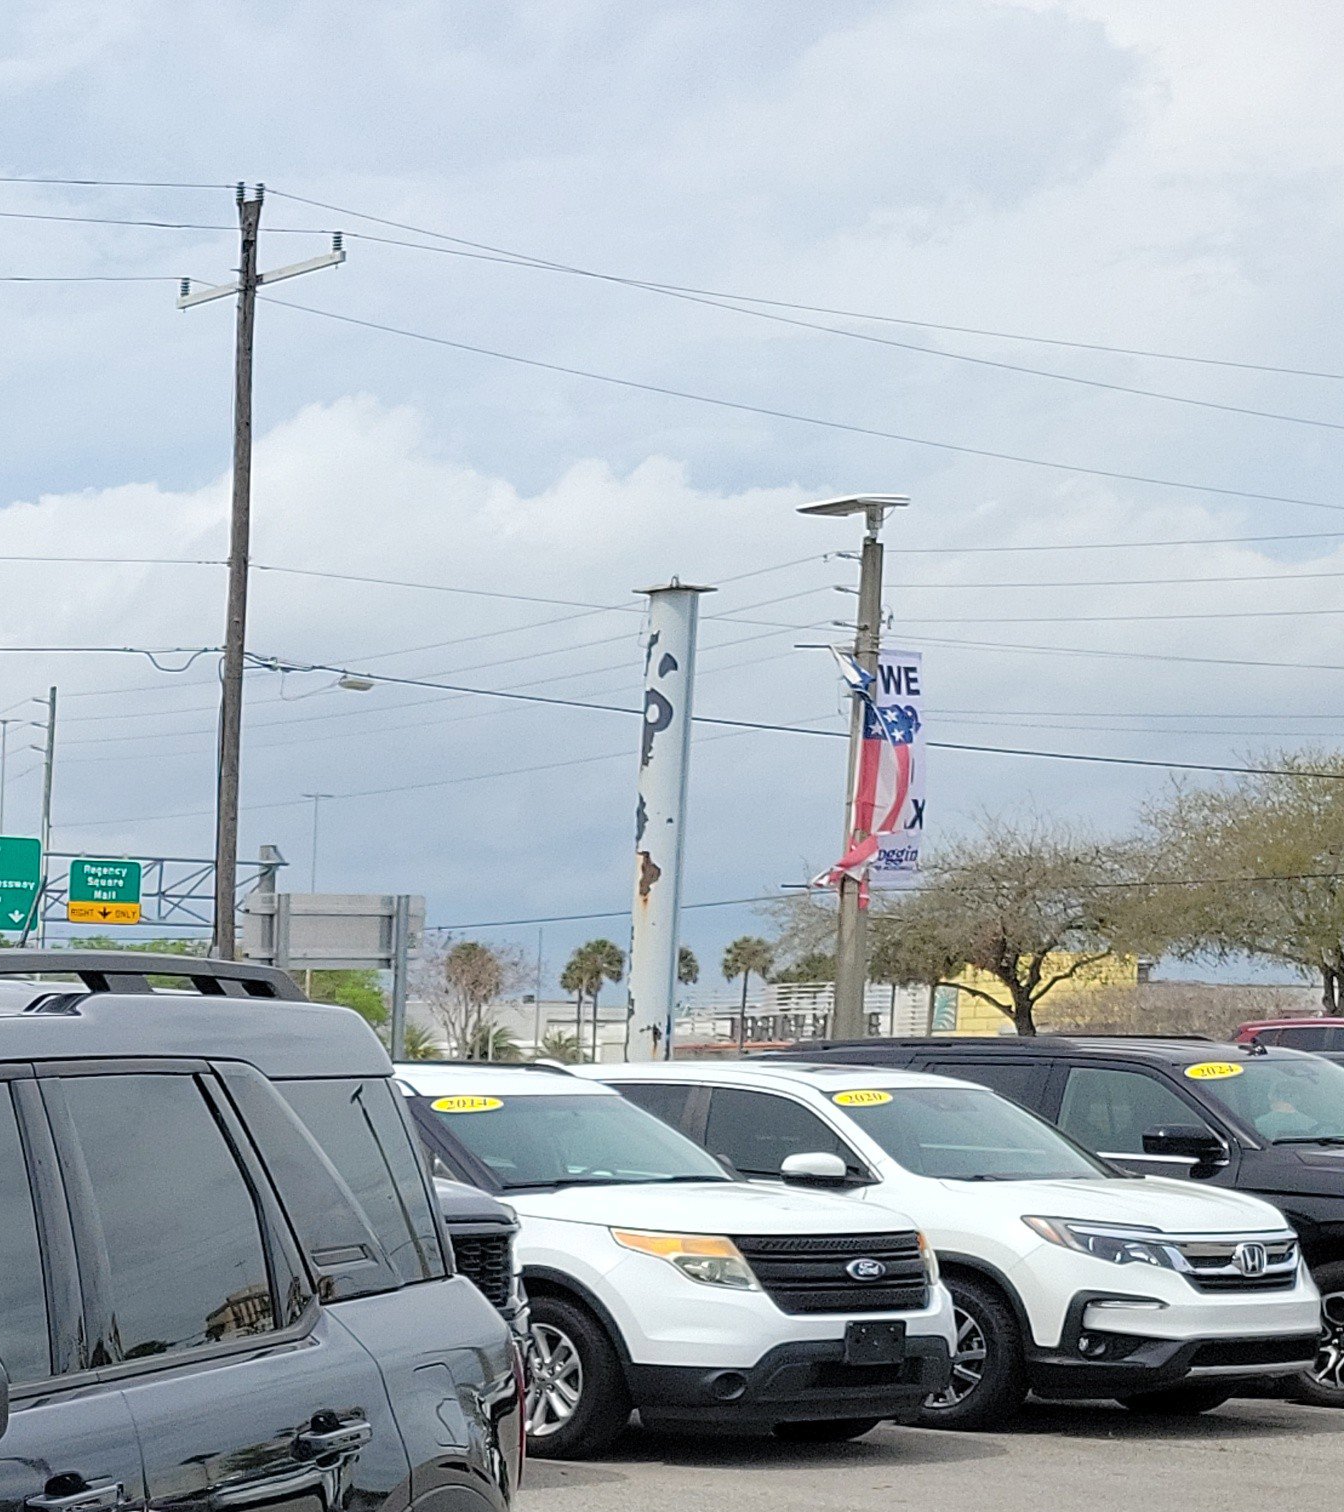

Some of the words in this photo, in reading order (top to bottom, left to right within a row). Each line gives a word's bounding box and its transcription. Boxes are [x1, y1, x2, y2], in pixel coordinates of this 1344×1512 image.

[878, 664, 921, 697] WE
[83, 864, 128, 878] Regency
[87, 876, 124, 888] Square
[93, 890, 117, 900] Mall
[443, 1097, 488, 1110] 2014
[844, 1092, 883, 1104] 2020
